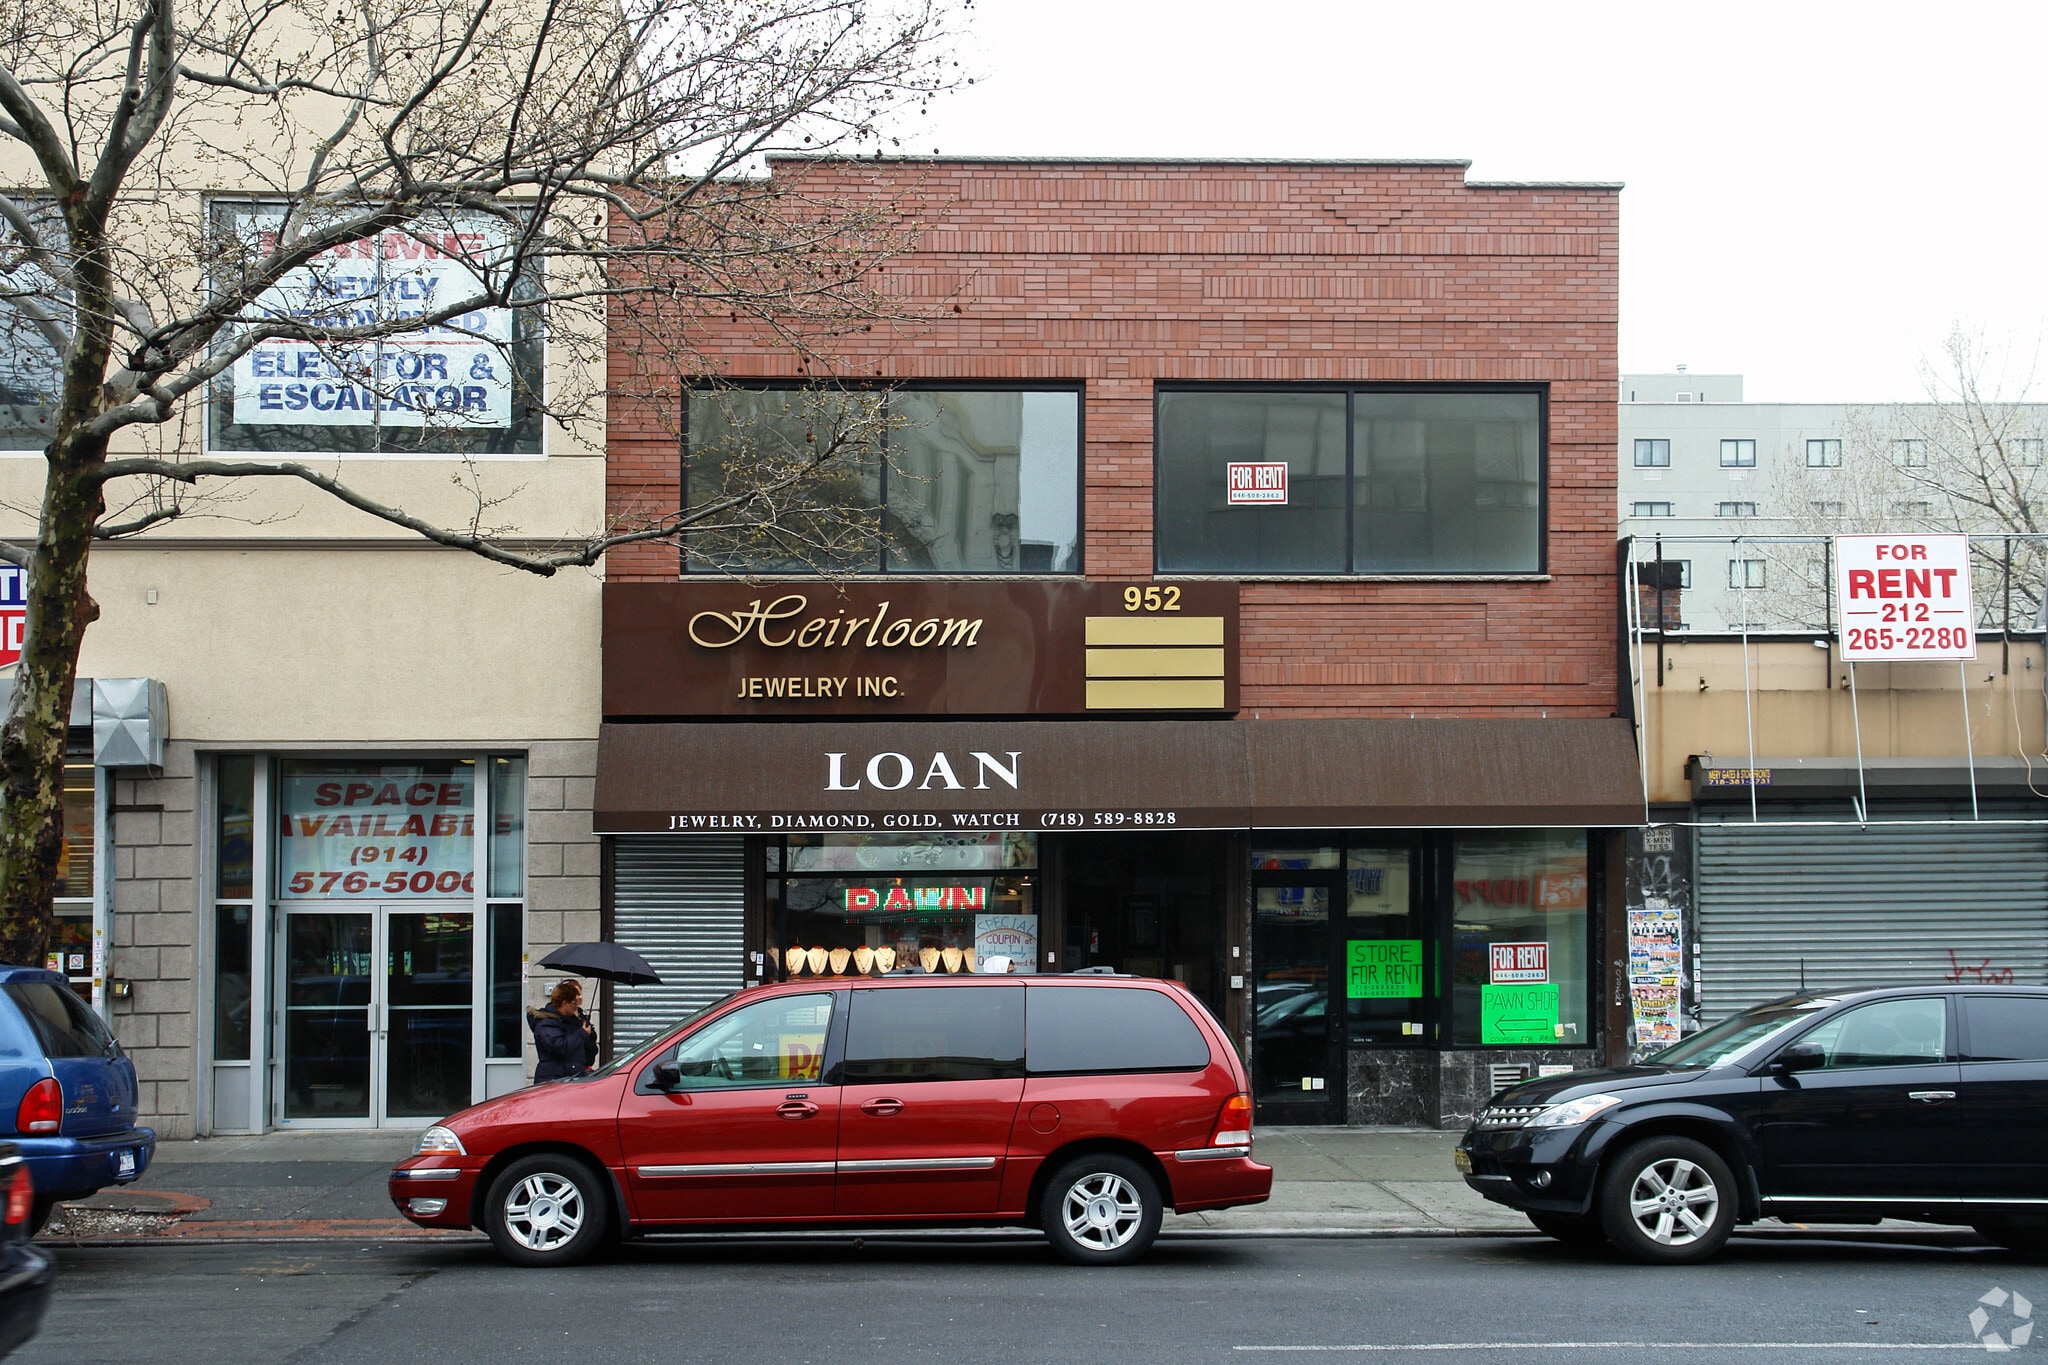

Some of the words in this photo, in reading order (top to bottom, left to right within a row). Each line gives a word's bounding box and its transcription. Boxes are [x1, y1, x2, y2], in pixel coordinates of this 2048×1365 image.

[309, 276, 440, 301] NEWLY
[469, 353, 495, 380] &
[259, 383, 488, 412] ESCALATOR
[1232, 466, 1253, 489] FOR
[1256, 466, 1284, 489] RENT
[1876, 544, 1927, 561] FOR
[1848, 568, 1957, 599] RENT
[1124, 586, 1181, 611] 952
[688, 594, 983, 648] Heirloom
[1882, 603, 1930, 622] 212
[1848, 627, 1967, 650] 265-2280
[737, 677, 848, 698] JEWELRY
[856, 676, 905, 698] INC.
[823, 752, 1022, 791] LOAN
[314, 783, 465, 806] SPACE
[669, 815, 762, 829] JEWELRY,
[771, 814, 875, 829] DIAMOND,
[883, 813, 942, 829] GOLD,
[952, 813, 1020, 826] WATCH
[1040, 812, 1084, 827] (718)
[1093, 812, 1177, 825] 589-8828
[350, 846, 428, 866] (914)
[1355, 945, 1413, 962] STORE
[1493, 947, 1514, 969] FOR
[1518, 946, 1545, 969] RENT
[1352, 965, 1379, 985] FOR
[1386, 964, 1422, 985] RENT
[1484, 992, 1524, 1011] PAWN
[1527, 991, 1558, 1011] SHOP
